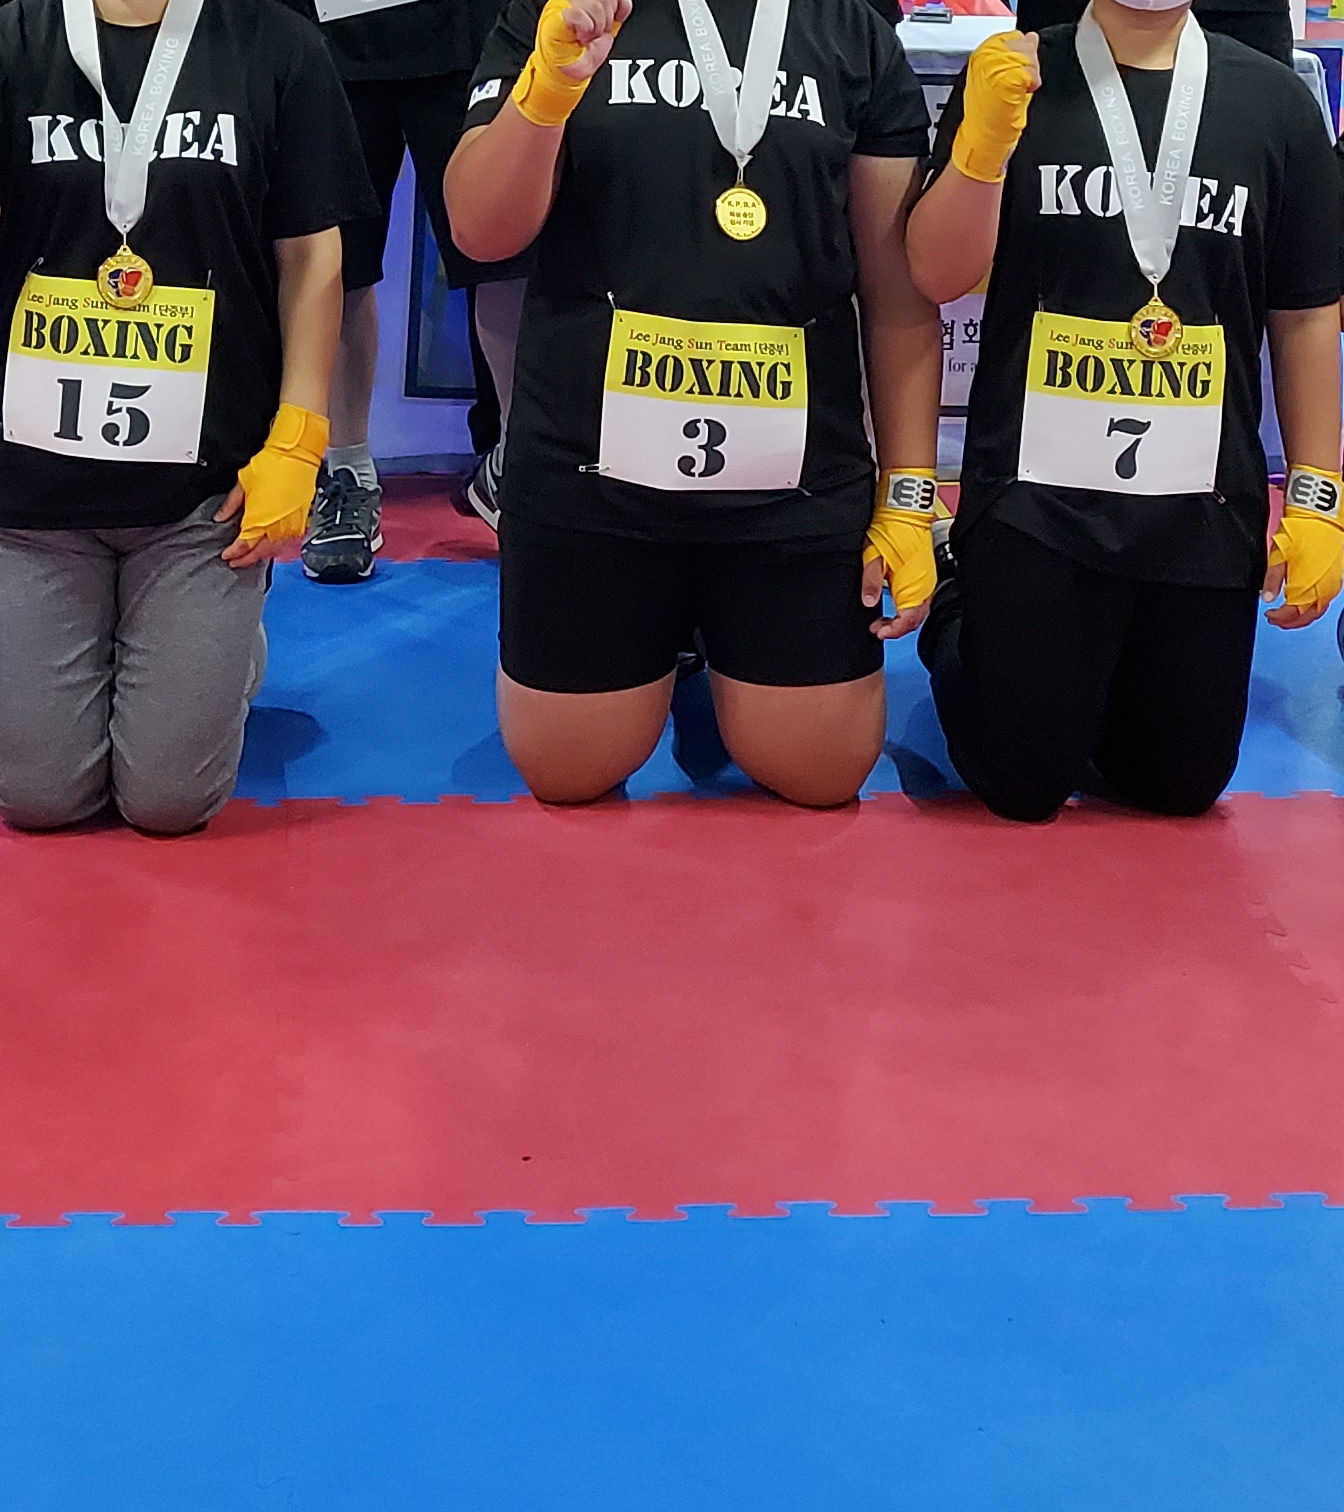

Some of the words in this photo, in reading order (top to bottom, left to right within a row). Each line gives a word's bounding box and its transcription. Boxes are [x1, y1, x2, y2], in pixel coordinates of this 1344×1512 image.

[27, 111, 238, 167] KOEA
[1037, 164, 1249, 238] KOEA
[27, 290, 44, 304] Lee
[45, 294, 79, 310] Jang
[83, 297, 109, 310] Sun
[22, 309, 194, 364] BOXING
[629, 329, 651, 344] Lee
[652, 331, 684, 351] Jang
[687, 338, 713, 352] Sun
[717, 339, 752, 353] Team
[1049, 329, 1070, 344] Lee
[1072, 333, 1104, 350] Jang
[622, 348, 793, 401] BOXING
[1043, 348, 1212, 400] BOXING
[53, 378, 152, 448] 15
[677, 418, 728, 479] 3
[1105, 417, 1153, 480] 7
